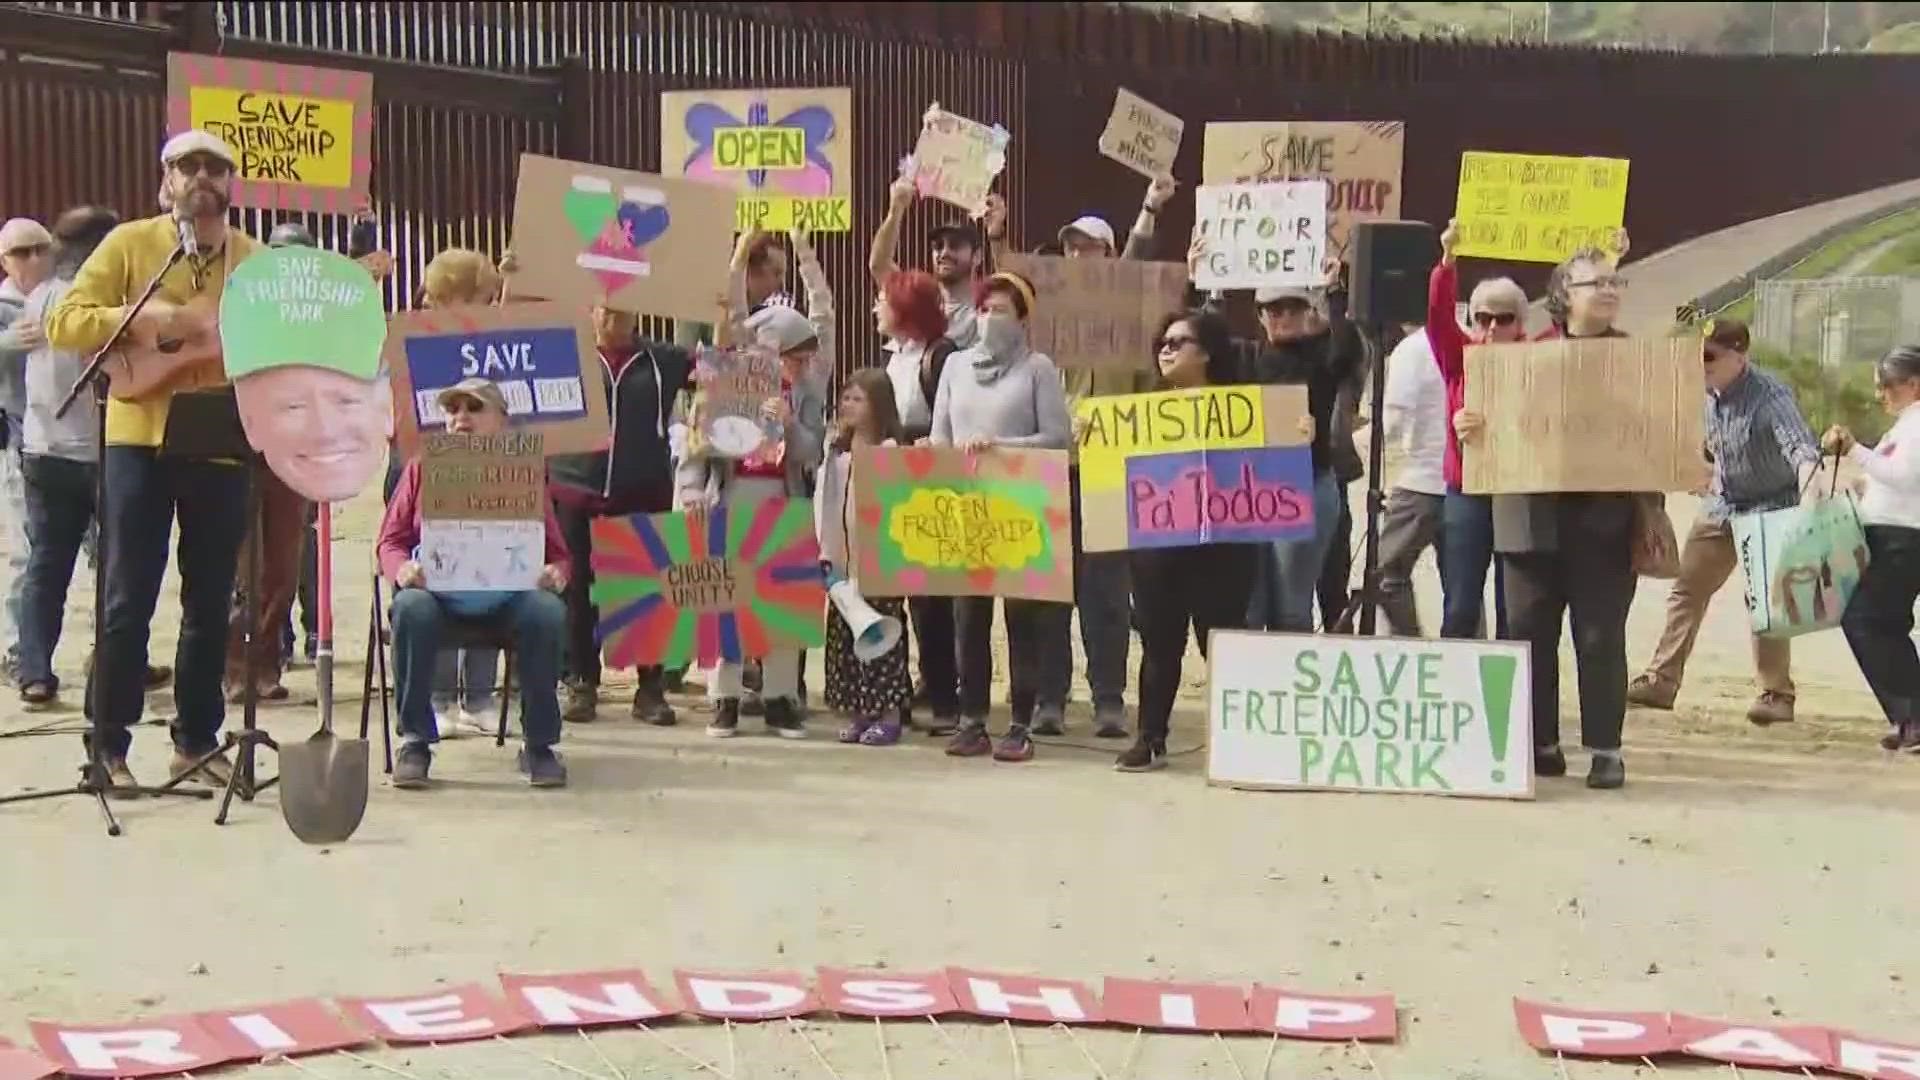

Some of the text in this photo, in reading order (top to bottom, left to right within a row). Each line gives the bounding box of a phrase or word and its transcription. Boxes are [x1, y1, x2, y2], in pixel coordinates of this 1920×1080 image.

[238, 93, 320, 128] SAVE
[204, 121, 335, 158] FRIENDSHIP
[717, 131, 802, 166] OPEN
[1256, 133, 1336, 176] SAVE
[241, 151, 302, 181] PARK
[791, 199, 847, 230] PARK
[279, 256, 322, 277] SAVE
[243, 277, 366, 307] FRIENDSHIP
[280, 302, 324, 322] PARK
[460, 342, 537, 376] SAVE
[1083, 391, 1254, 447] AMISTAD
[1186, 463, 1301, 525] Todos
[668, 559, 737, 585] CHOOSE
[672, 582, 737, 607] UNITY
[1293, 649, 1443, 699] SAVE
[1221, 689, 1475, 743] FRIENDSHIP
[1300, 738, 1454, 790] PARK
